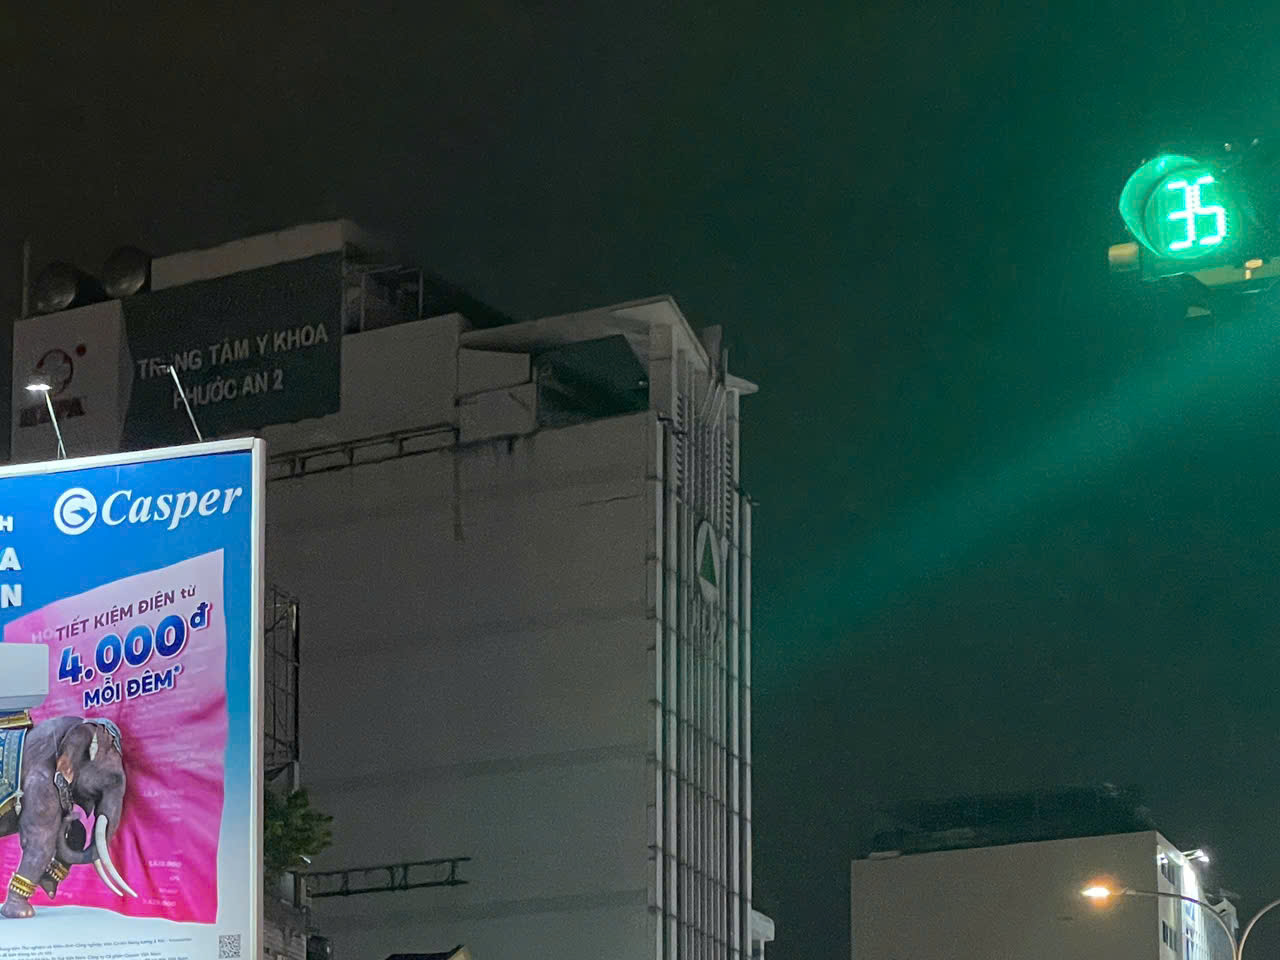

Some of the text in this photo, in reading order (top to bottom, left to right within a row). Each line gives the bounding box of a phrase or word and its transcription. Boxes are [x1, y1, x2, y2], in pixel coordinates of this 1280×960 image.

[1167, 174, 1227, 250] 35
[136, 323, 329, 380] TRNG TÂM Y KHOA
[242, 372, 269, 394] AN
[272, 369, 284, 391] 2
[101, 487, 243, 531] Casper
[55, 614, 90, 642] TIẾT
[94, 604, 133, 630] KIỆM
[138, 590, 175, 615] ĐIỆN
[84, 676, 120, 709] MỖI
